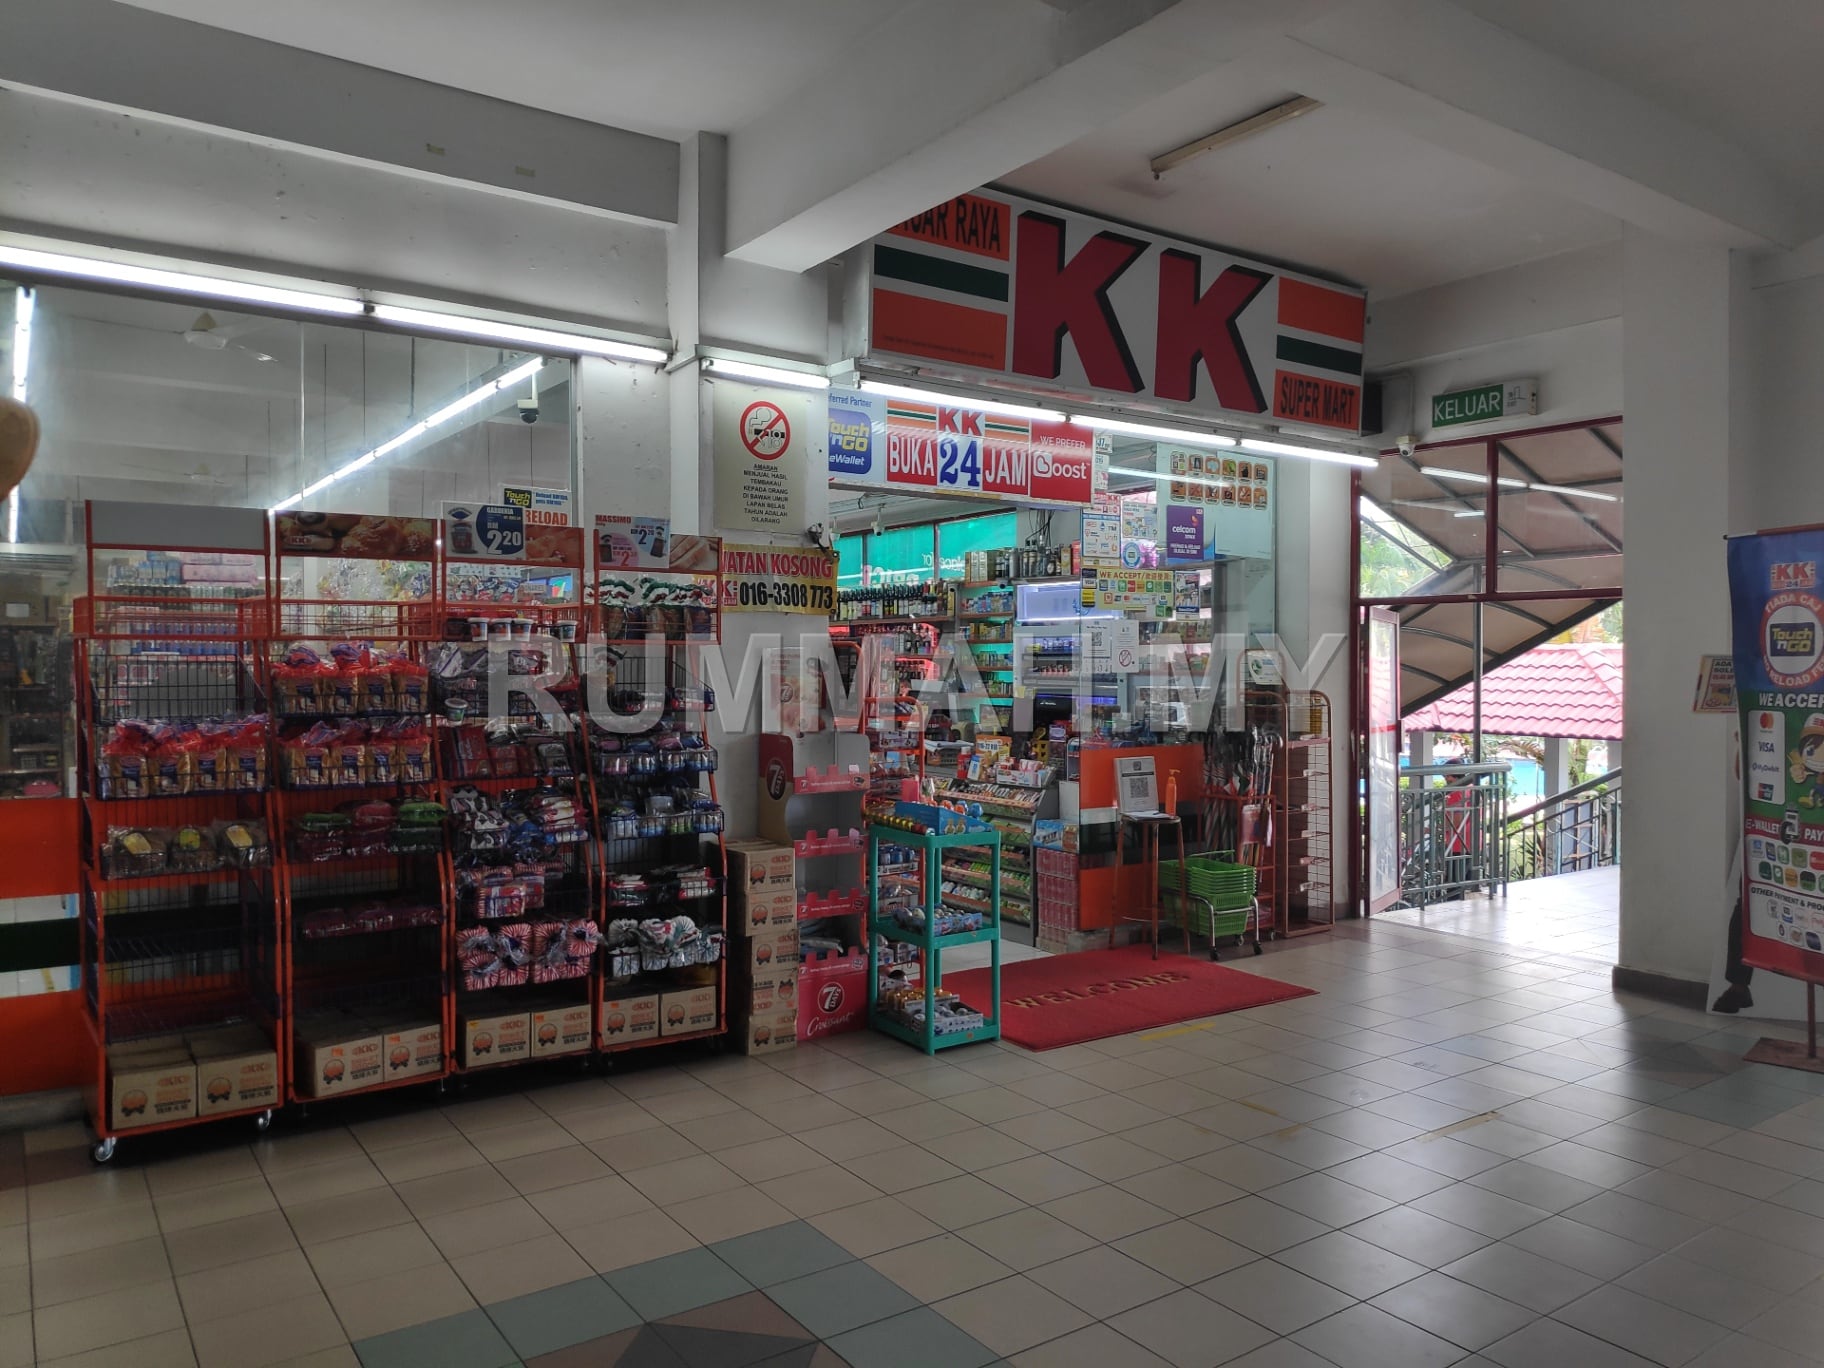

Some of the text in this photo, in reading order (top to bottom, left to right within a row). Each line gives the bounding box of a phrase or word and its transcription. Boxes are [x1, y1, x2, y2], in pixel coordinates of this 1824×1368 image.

[955, 199, 1001, 253] RAYA
[1012, 210, 1273, 415] KK
[850, 395, 872, 408] Partner
[1280, 375, 1355, 425] SUPER MART
[1434, 391, 1500, 421] KELUAR
[938, 406, 984, 436] KK
[1040, 435, 1055, 447] WE
[1055, 437, 1086, 449] PREFER
[829, 453, 865, 466] eWallet
[889, 434, 1027, 488] BUKA 24 JAM
[505, 490, 531, 500] Touch
[743, 485, 767, 493] KEPADA
[525, 509, 568, 527] RELOAD
[595, 514, 632, 524] MASSIMO
[1172, 524, 1196, 534] celcom
[770, 553, 833, 579] KOSONG
[1775, 563, 1809, 580] KK
[1100, 571, 1111, 579] WE
[1771, 628, 1813, 641] Touch
[1759, 693, 1774, 706] WE
[1758, 741, 1775, 753] VISA
[1803, 828, 1824, 841] PAY
[1750, 886, 1774, 898] OTHER
[1774, 893, 1799, 906] PAYMENT
[1003, 970, 1193, 1009] WELCOME
